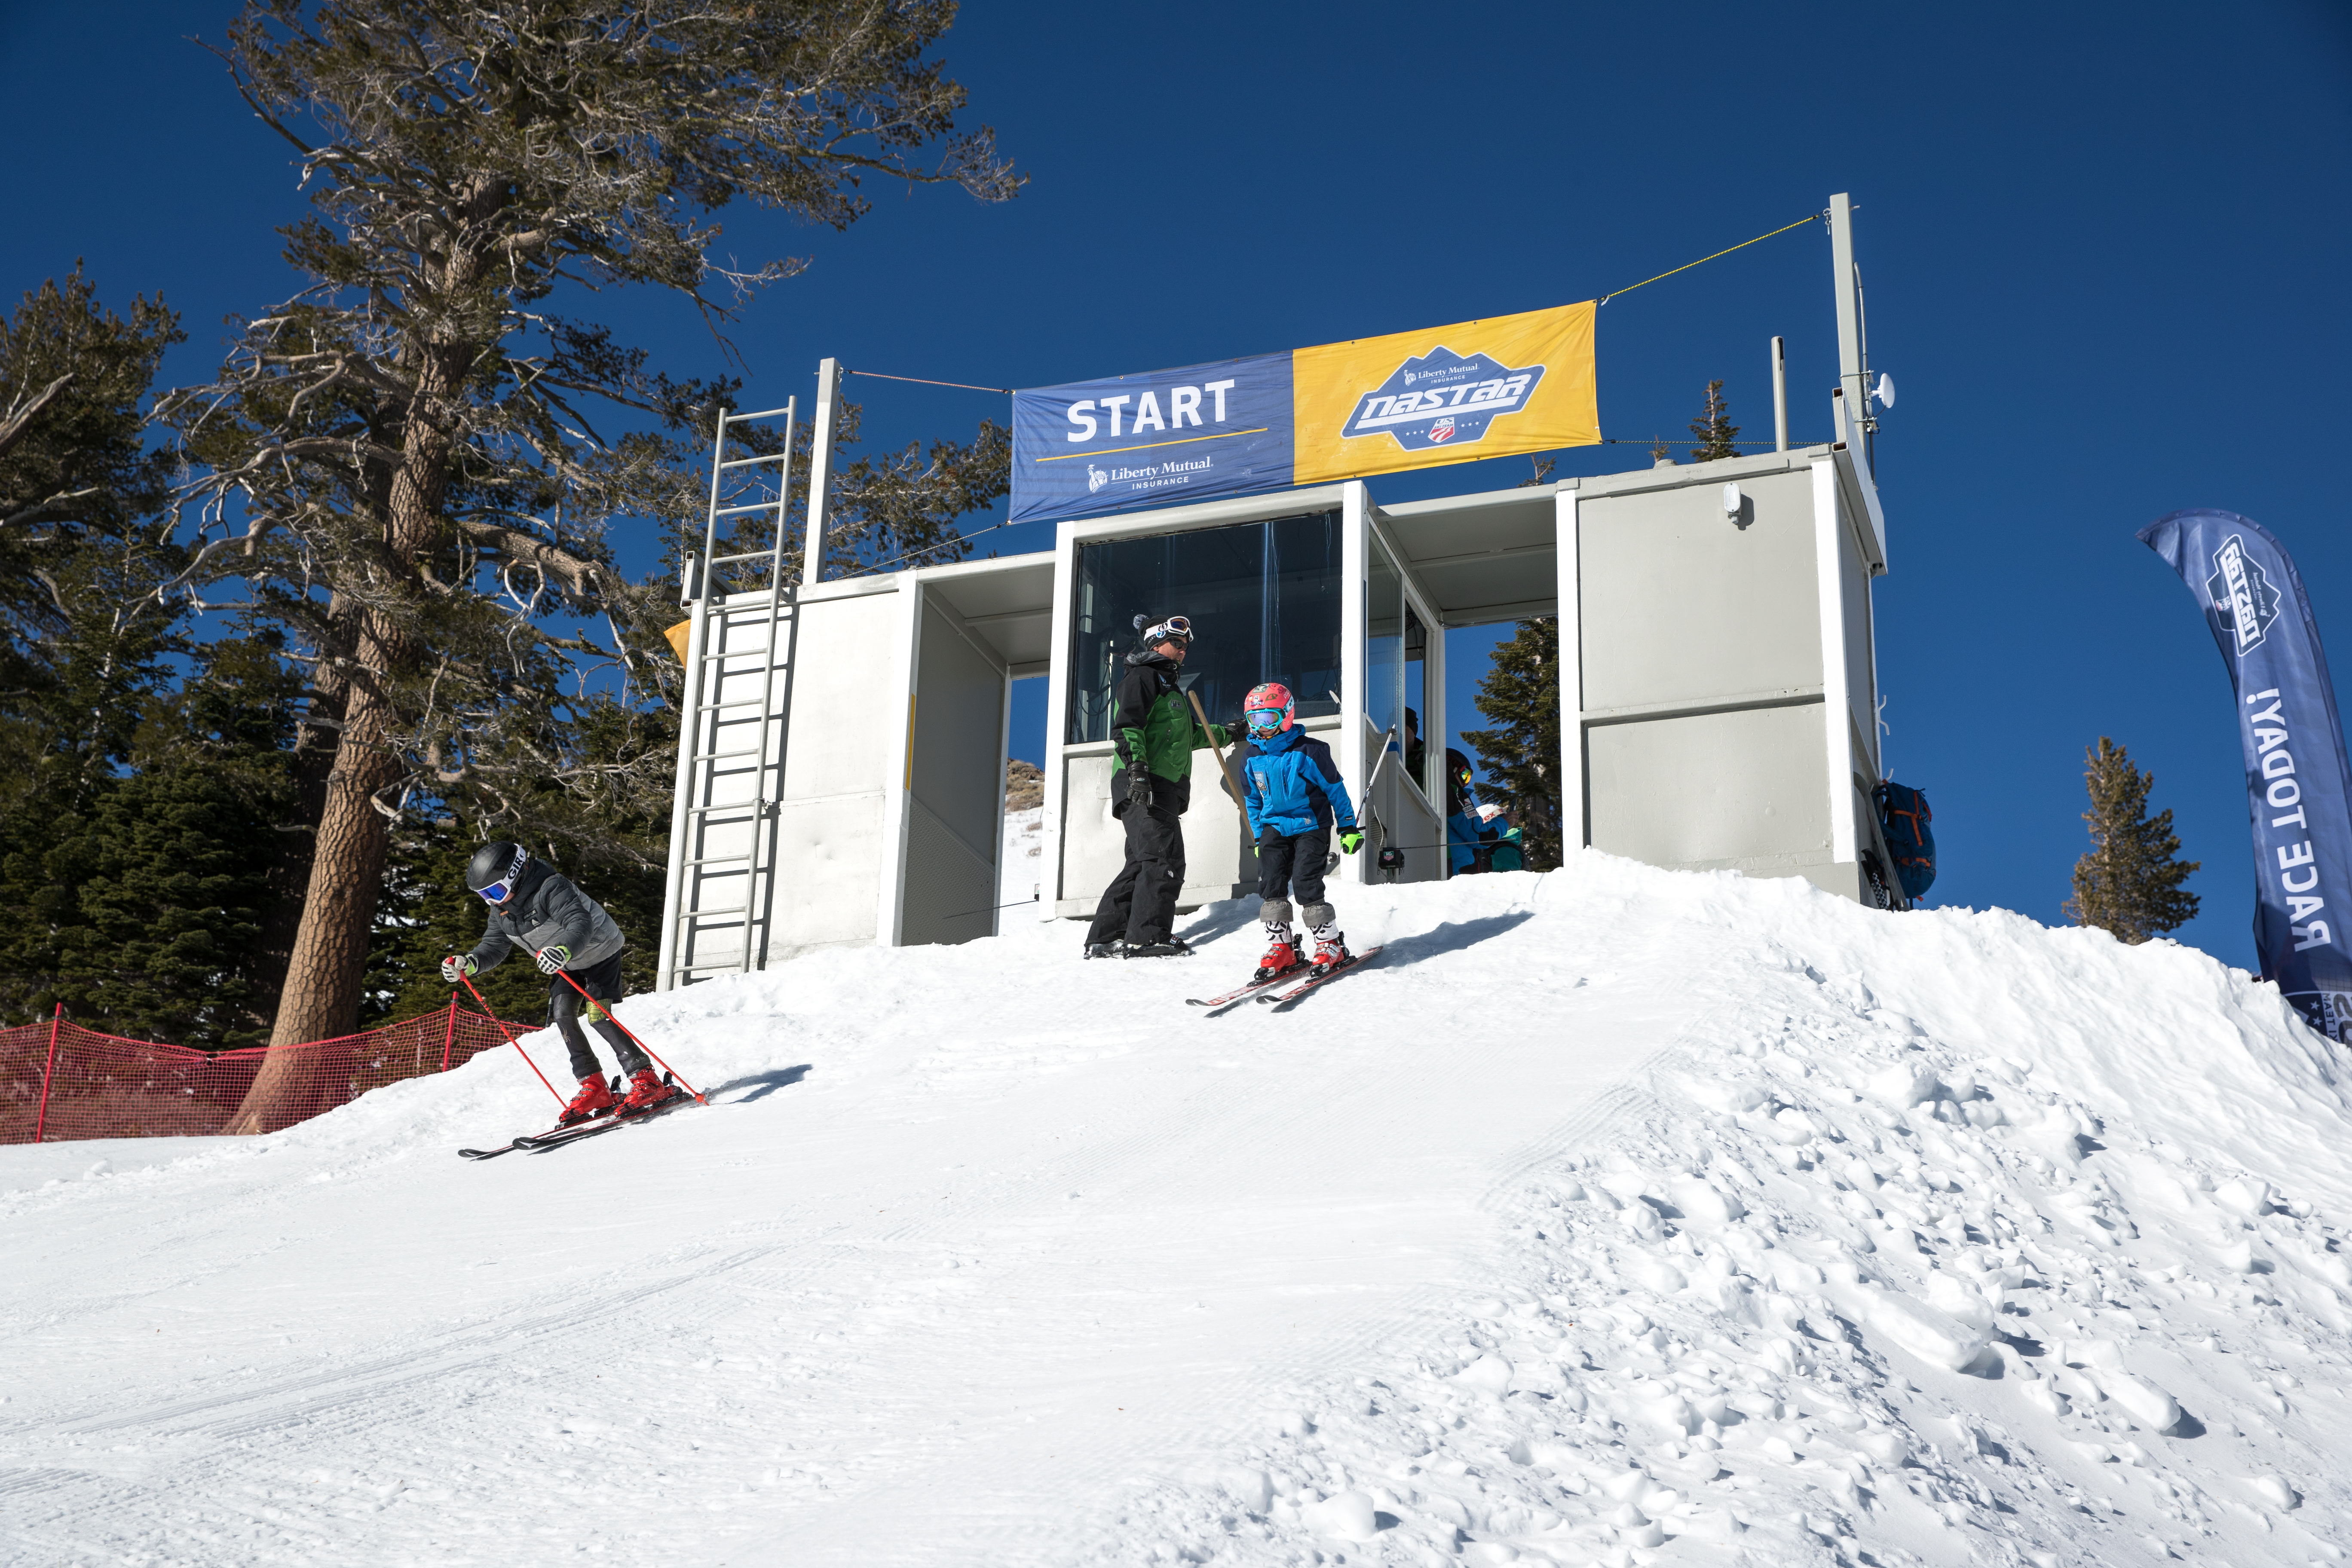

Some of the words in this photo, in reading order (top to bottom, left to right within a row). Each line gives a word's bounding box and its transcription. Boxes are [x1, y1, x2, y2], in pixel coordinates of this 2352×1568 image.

[1418, 369, 1447, 379] Liberty
[1448, 363, 1478, 374] Mutual
[1431, 374, 1466, 384] INSURANCE
[1067, 379, 1235, 442] START
[1111, 464, 1159, 481] Liberty
[1161, 456, 1211, 474] Mutual
[1132, 476, 1189, 490] INSURANCE
[548, 949, 562, 960] reusch
